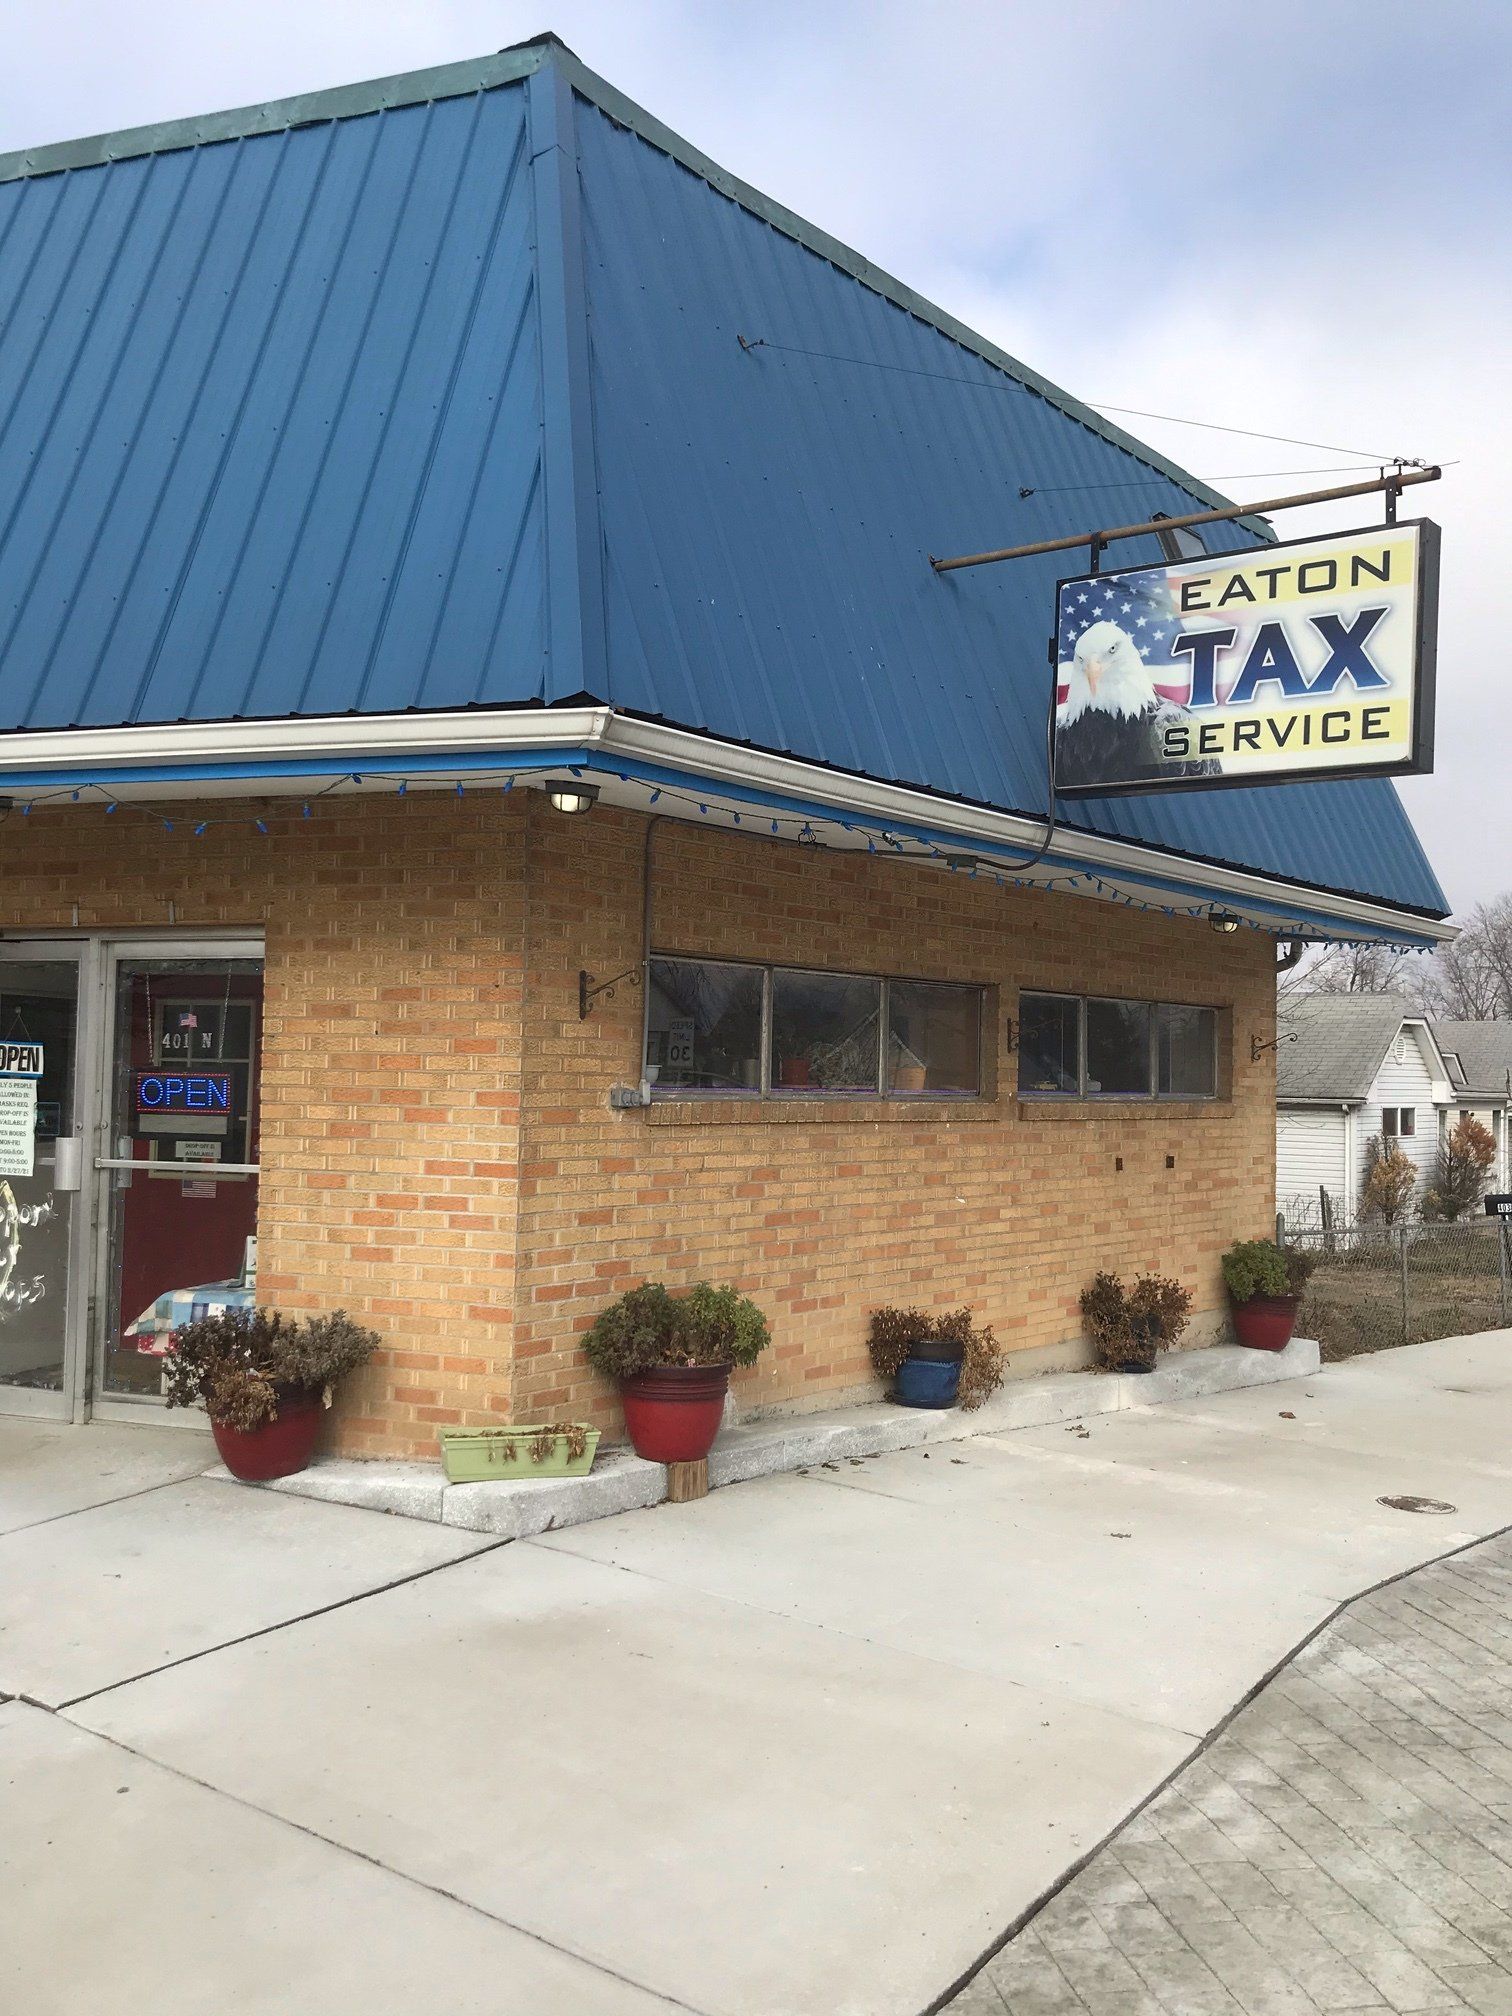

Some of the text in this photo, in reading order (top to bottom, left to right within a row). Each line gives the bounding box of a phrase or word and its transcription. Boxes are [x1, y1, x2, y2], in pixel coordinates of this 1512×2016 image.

[1181, 550, 1391, 612] EATON
[1170, 606, 1391, 708] TAX
[1163, 707, 1391, 758] SERVICE
[0, 1045, 40, 1072] OPEN
[162, 1032, 212, 1048] 401 N
[141, 1078, 227, 1107] OPEN
